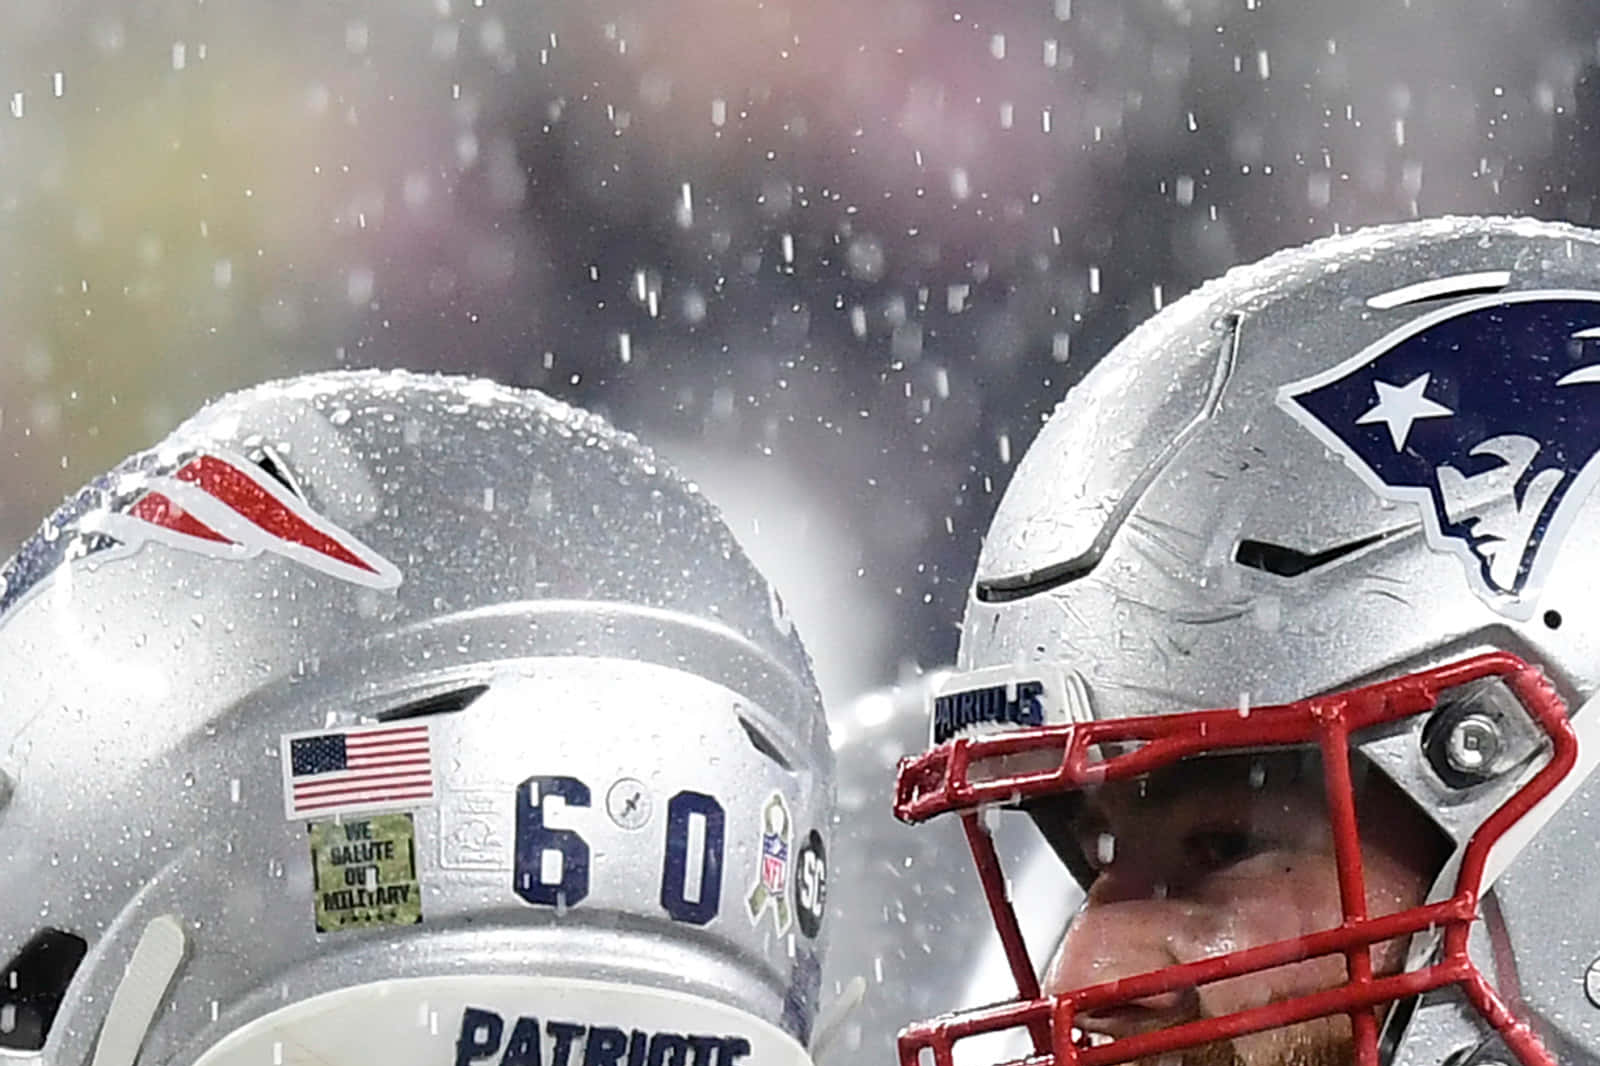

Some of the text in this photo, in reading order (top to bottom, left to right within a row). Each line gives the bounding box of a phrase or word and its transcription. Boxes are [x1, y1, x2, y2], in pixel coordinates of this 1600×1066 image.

[344, 821, 372, 840] WE
[331, 840, 395, 866] SALUTE
[323, 884, 411, 912] MILITARY
